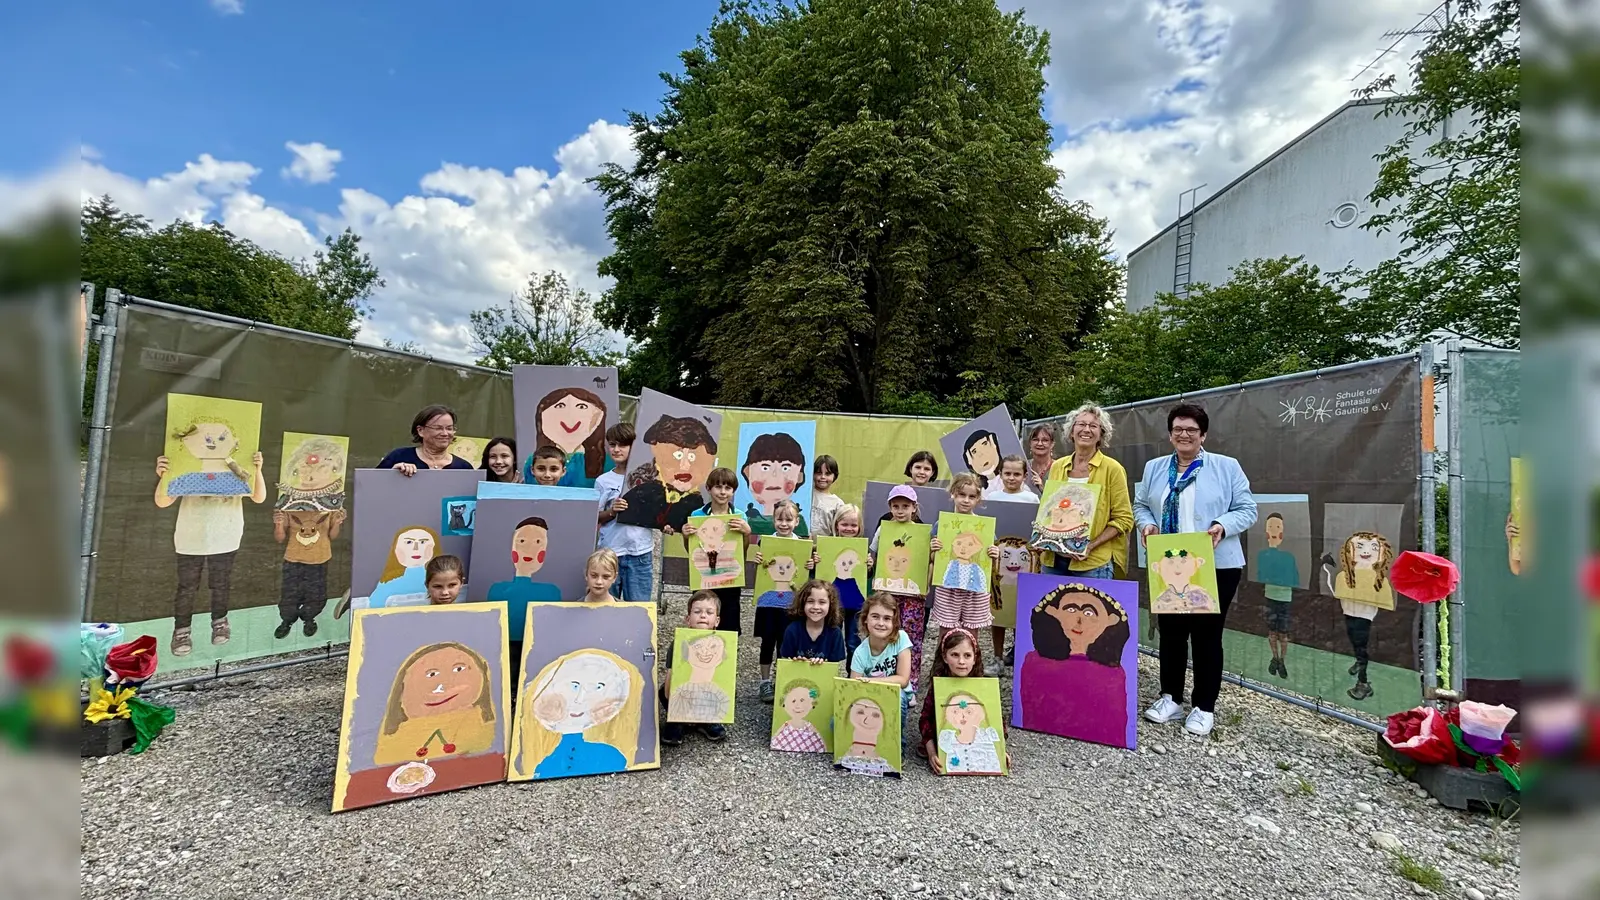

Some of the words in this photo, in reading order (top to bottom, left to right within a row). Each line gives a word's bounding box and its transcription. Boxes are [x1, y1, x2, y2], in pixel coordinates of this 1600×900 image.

[1336, 389, 1364, 400] Schule
[1366, 387, 1382, 395] der
[1334, 407, 1369, 416] Gauting
[1371, 402, 1391, 412] e.V.
[1335, 397, 1371, 408] Fantasie
